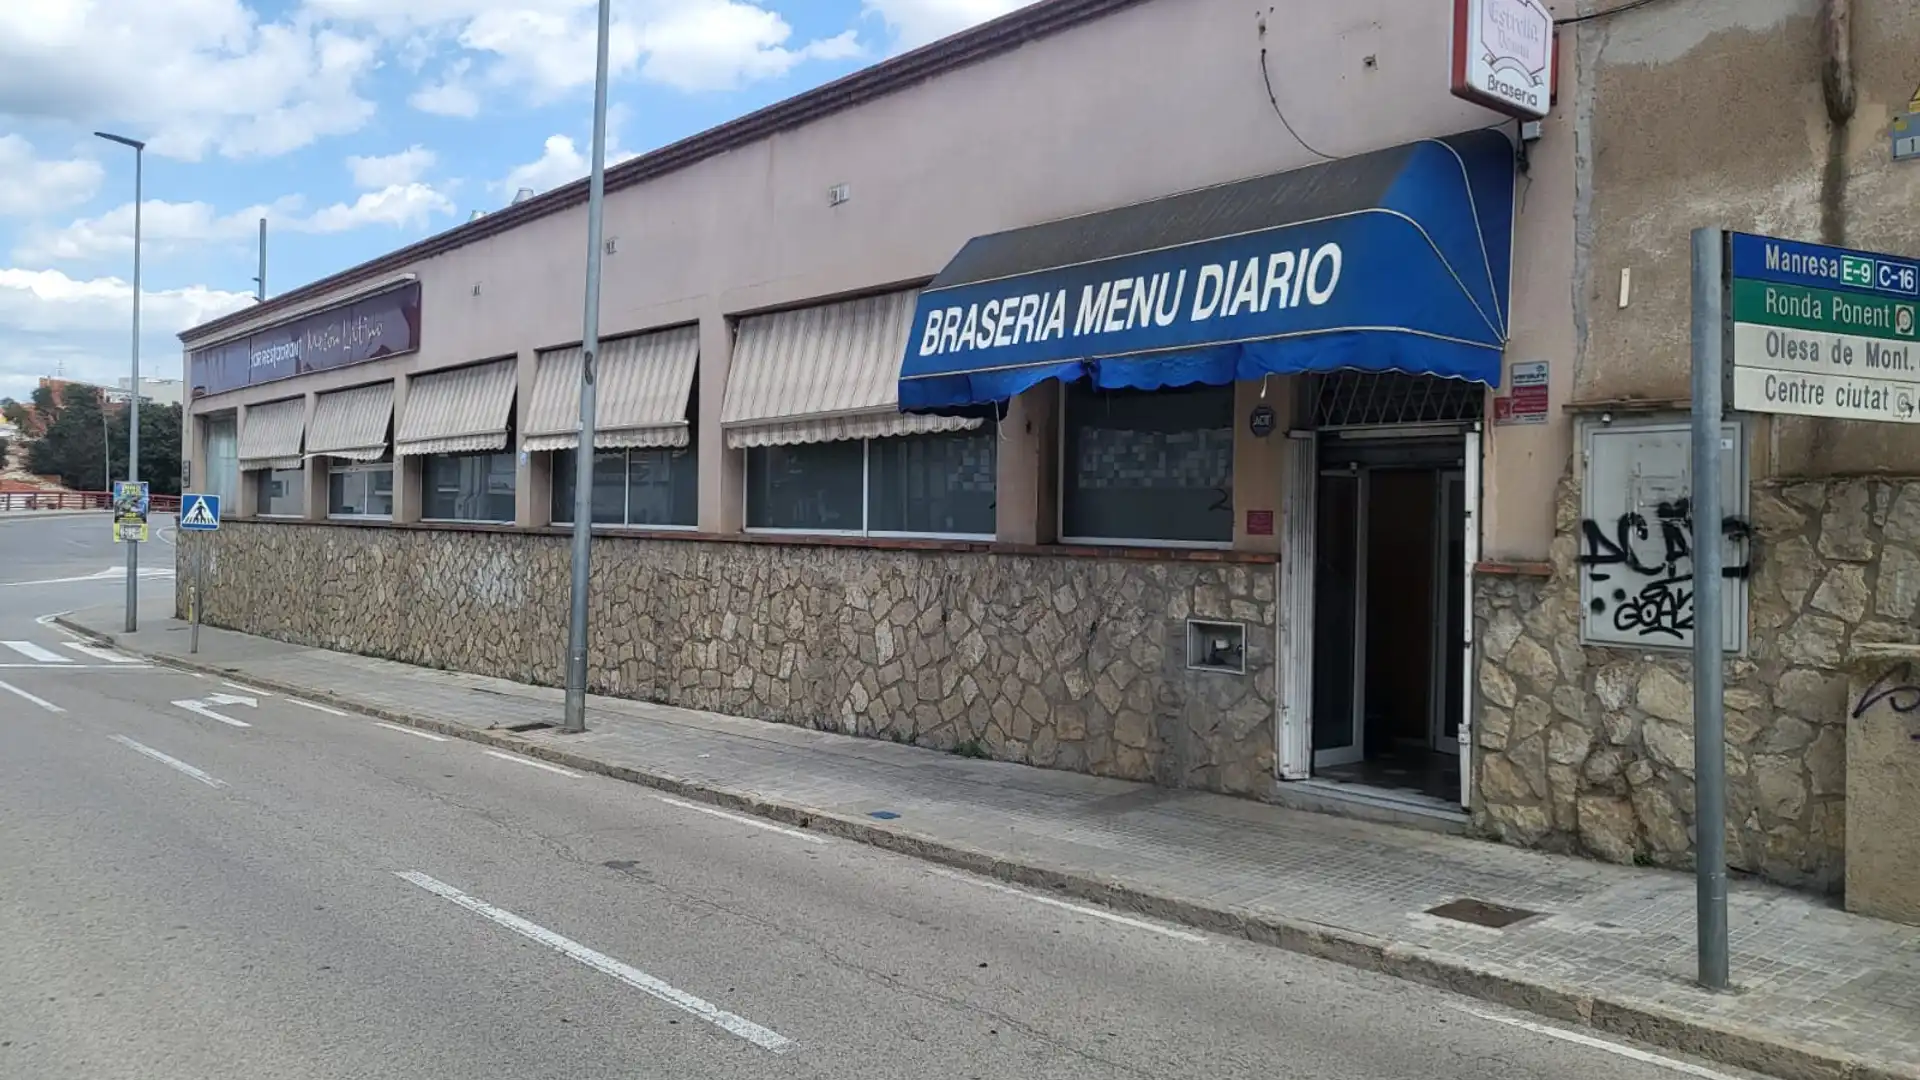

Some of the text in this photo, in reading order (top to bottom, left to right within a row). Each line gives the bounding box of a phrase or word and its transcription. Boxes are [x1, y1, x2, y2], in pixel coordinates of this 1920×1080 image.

[1488, 74, 1538, 106] Braseria
[1765, 243, 1914, 290] Manresa E-9 C-16
[919, 242, 1343, 357] BRASERIA MENU DIARIO
[1766, 288, 1890, 328] Ronda Ponent
[1766, 331, 1915, 371] Olesa de Mont.
[1765, 375, 1889, 411] Centre ciutat
